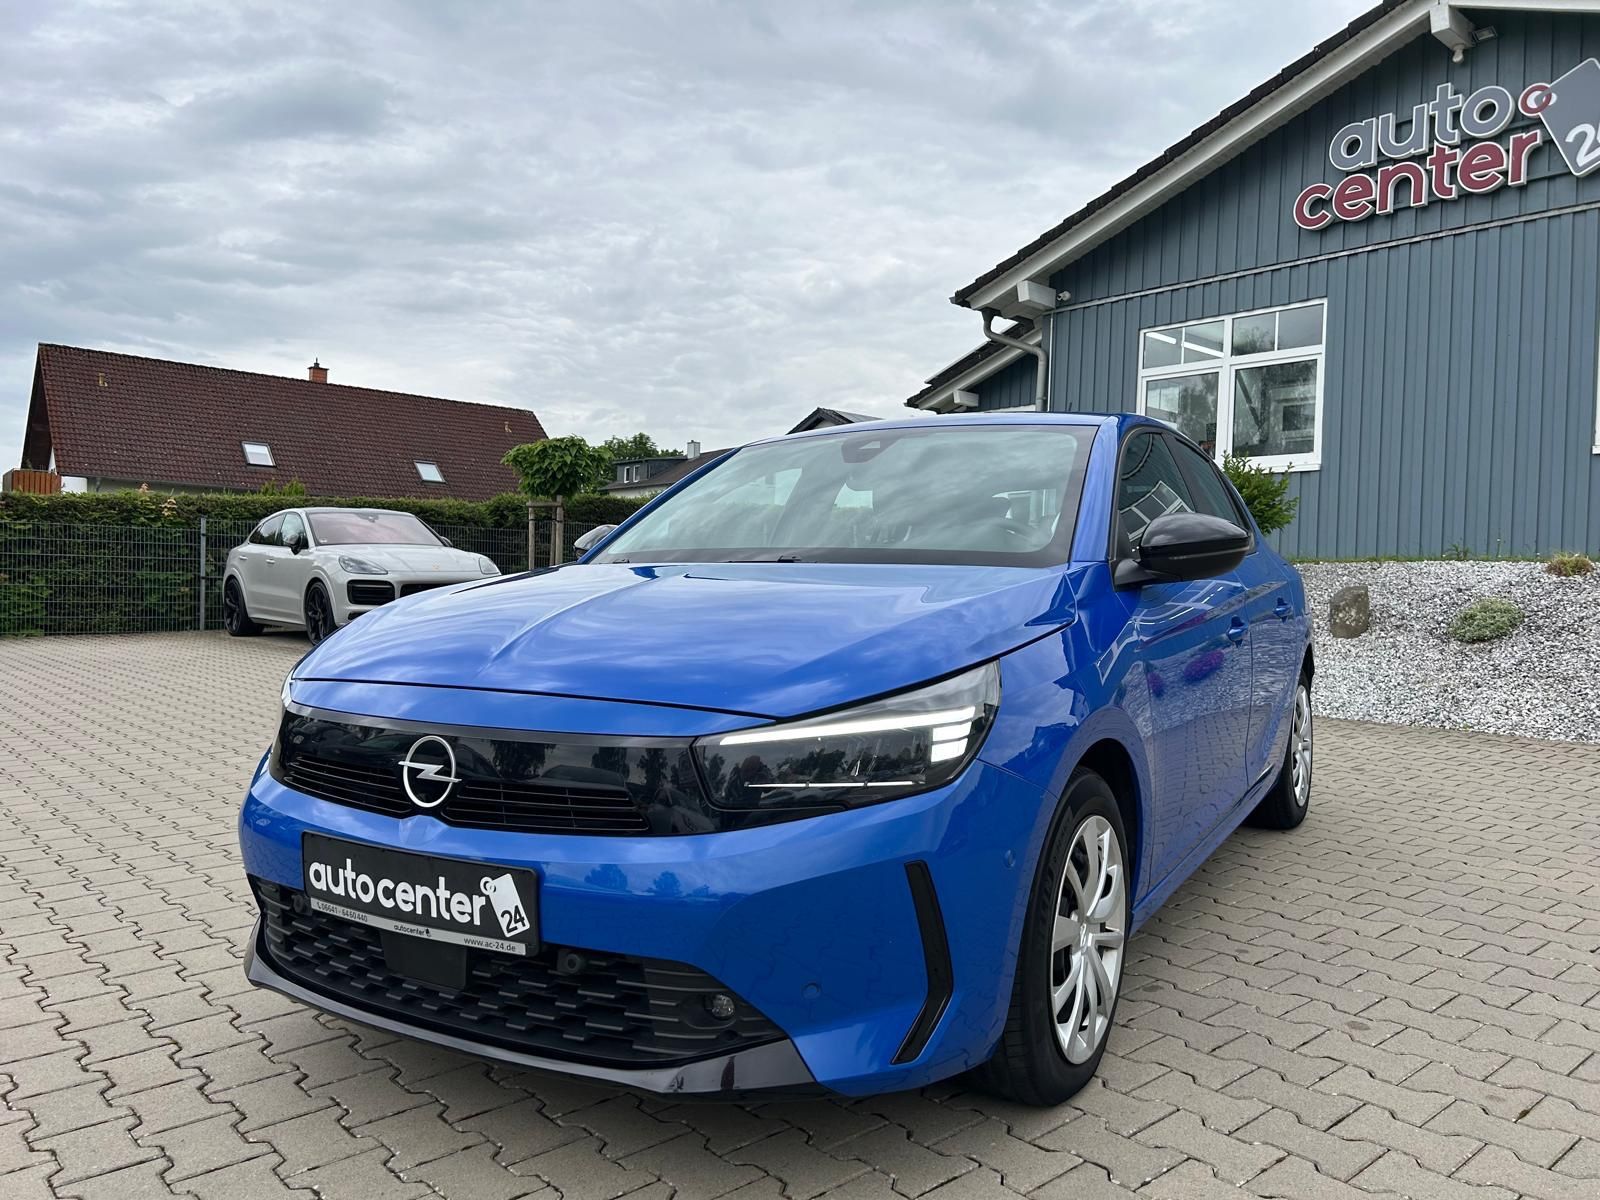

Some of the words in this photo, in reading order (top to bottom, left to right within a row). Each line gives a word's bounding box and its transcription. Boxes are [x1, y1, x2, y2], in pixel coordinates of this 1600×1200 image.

[1329, 82, 1515, 171] auto
[1565, 122, 1600, 167] 2
[1293, 129, 1542, 230] center
[394, 924, 425, 935] autocenter
[500, 904, 526, 934] 24
[463, 937, 516, 953] www.ac-24.de
